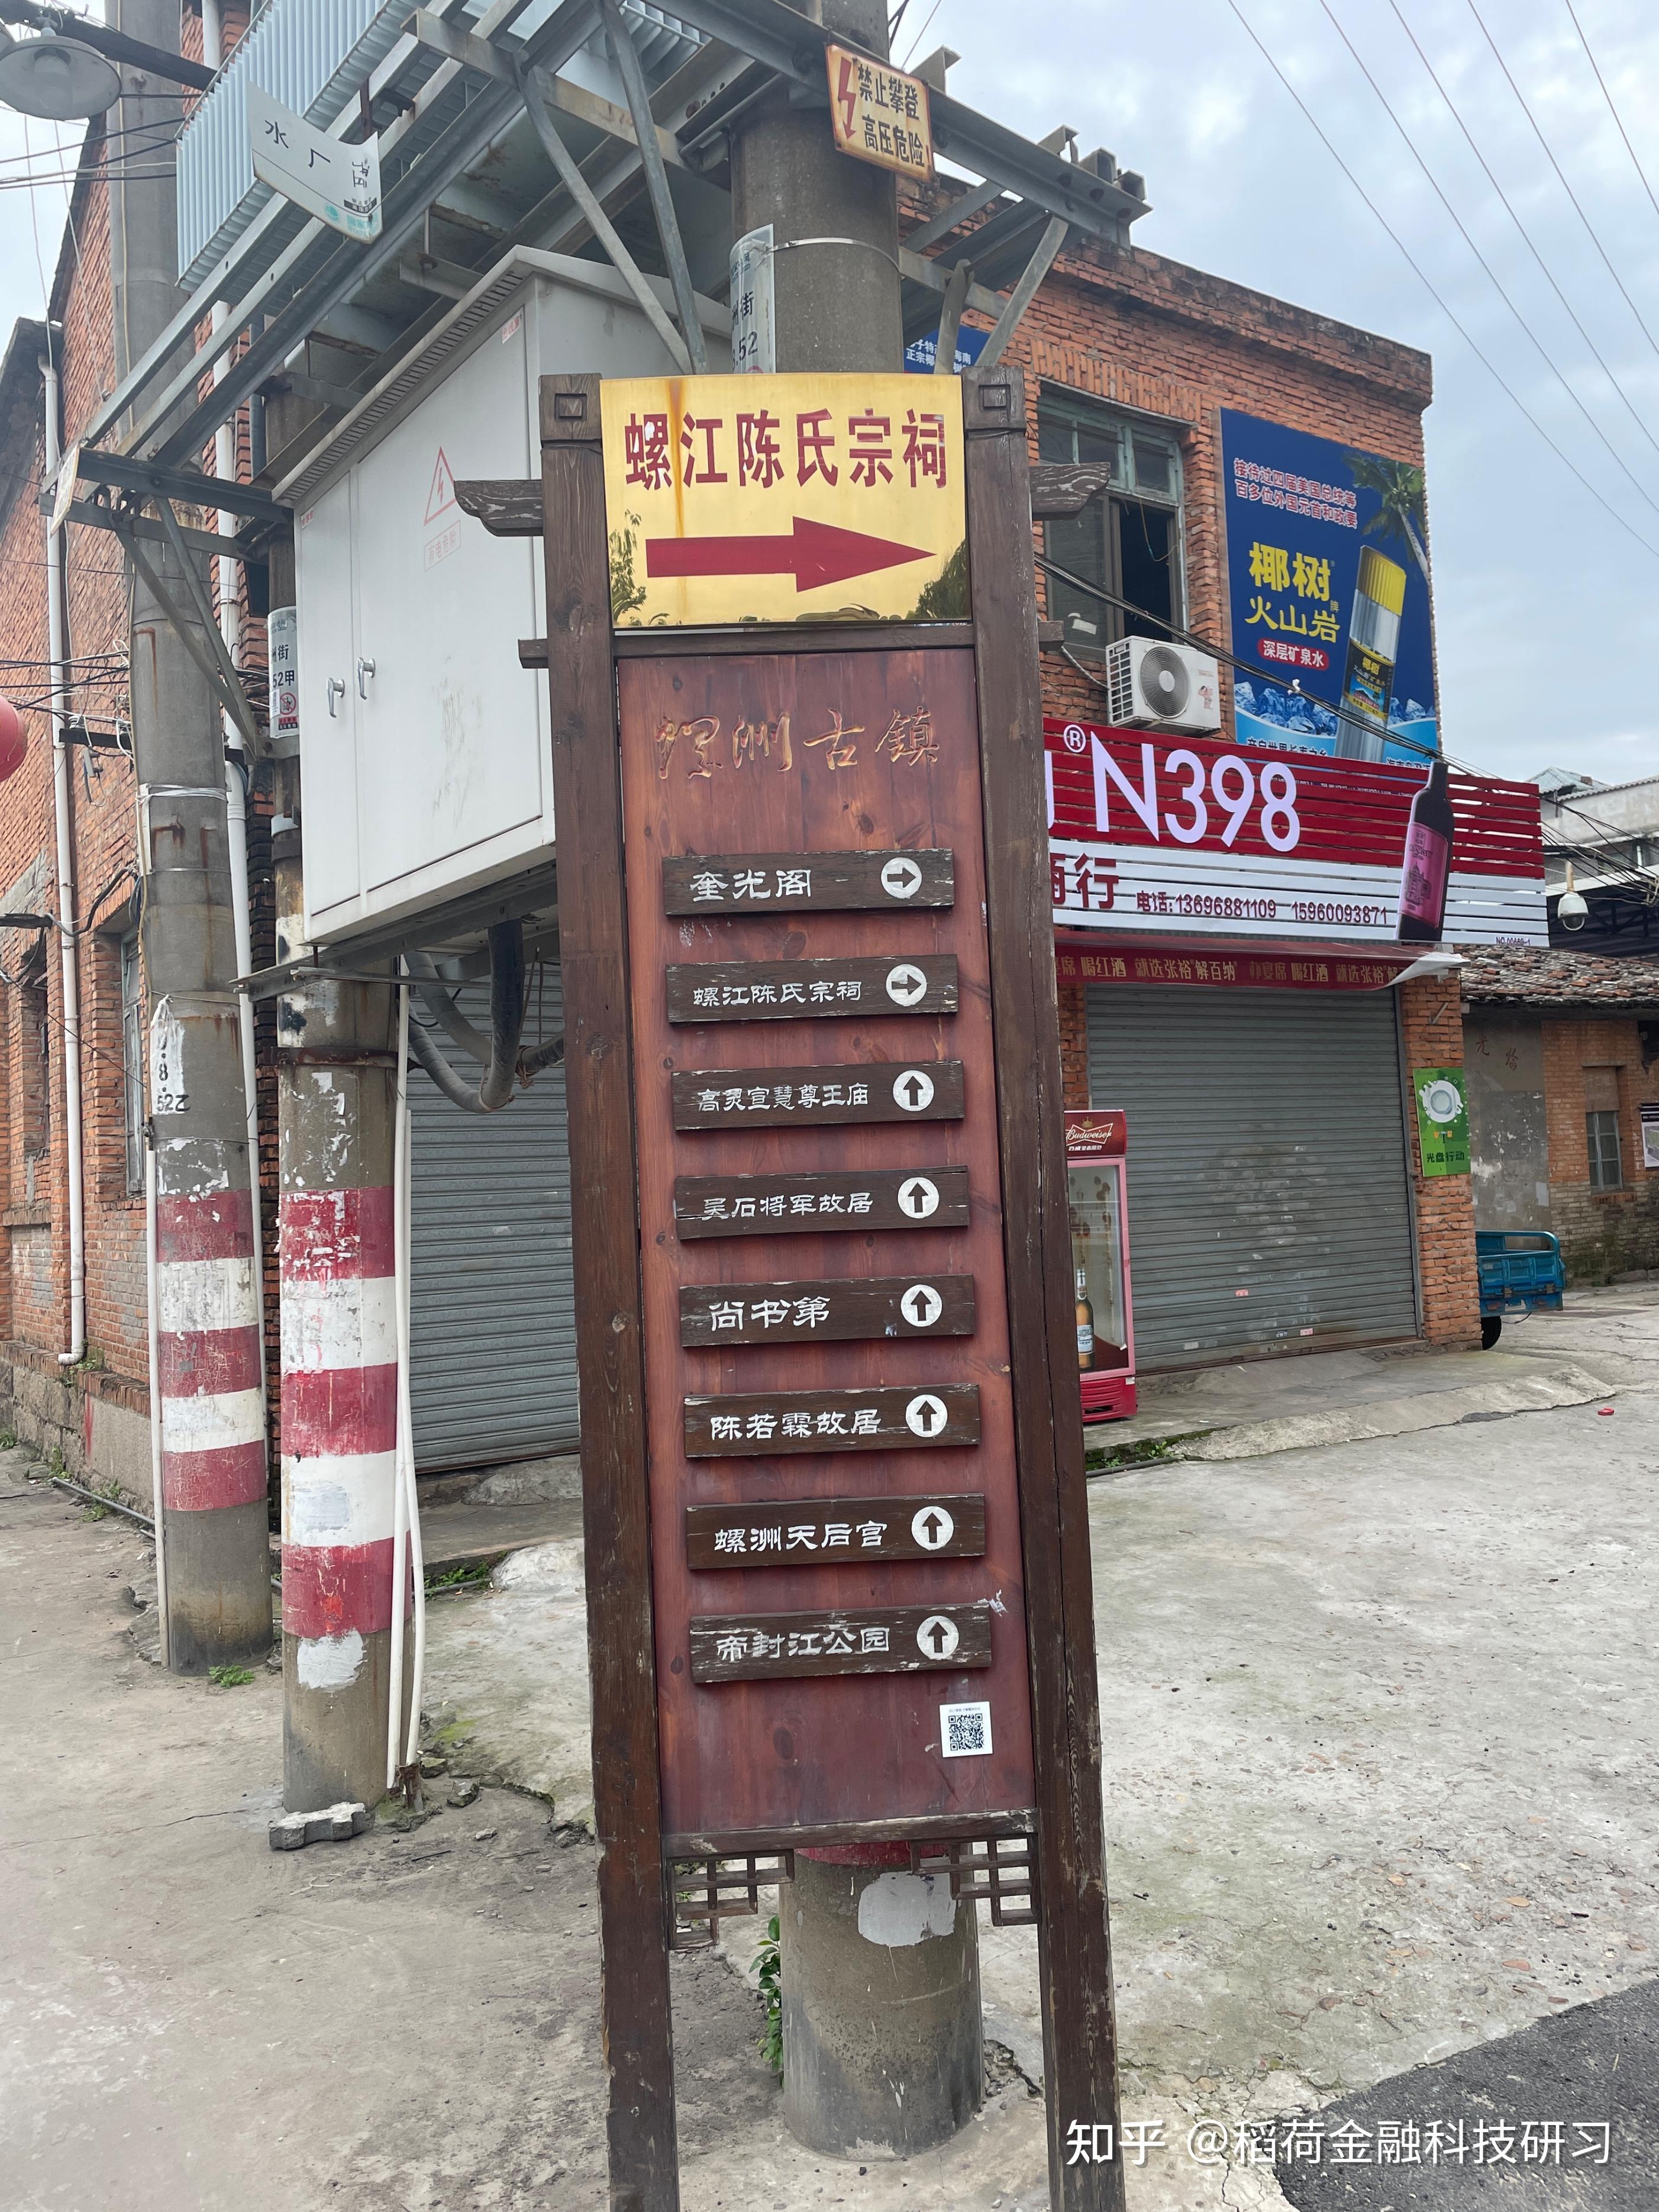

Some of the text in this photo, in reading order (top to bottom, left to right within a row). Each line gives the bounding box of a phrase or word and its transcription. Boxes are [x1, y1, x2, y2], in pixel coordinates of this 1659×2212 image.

[858, 63, 919, 120] 禁止攀登
[862, 114, 925, 167] 高压危险
[625, 408, 947, 491] 螺江陈氏宗祠
[1234, 457, 1357, 509] 接待过四届美国总统等
[1235, 478, 1358, 530] 百多位外国元首和政要
[1249, 541, 1331, 602] 椰树
[1244, 595, 1341, 643] 火山岩
[1263, 640, 1325, 668] 深层矿泉水
[1090, 731, 1300, 852] N398
[690, 869, 812, 902] 奎光阁
[1291, 899, 1387, 925] 15960093871
[1080, 956, 1127, 978] 喝红酒
[1291, 963, 1328, 982] 喝红酒
[693, 980, 863, 1007] 螺江陈氏宗祠
[697, 1082, 869, 1113] 高灵宣慧尊王庙
[1067, 1128, 1112, 1141] Budweiser
[1426, 1150, 1465, 1163] 光盘行动
[702, 1192, 874, 1221] 吴石将军故居
[708, 1295, 831, 1332] 尚书第
[711, 1408, 882, 1440] 陈若霖故居
[714, 1519, 888, 1553] 螺洲天后宫
[716, 1627, 890, 1663] 帝封江公园
